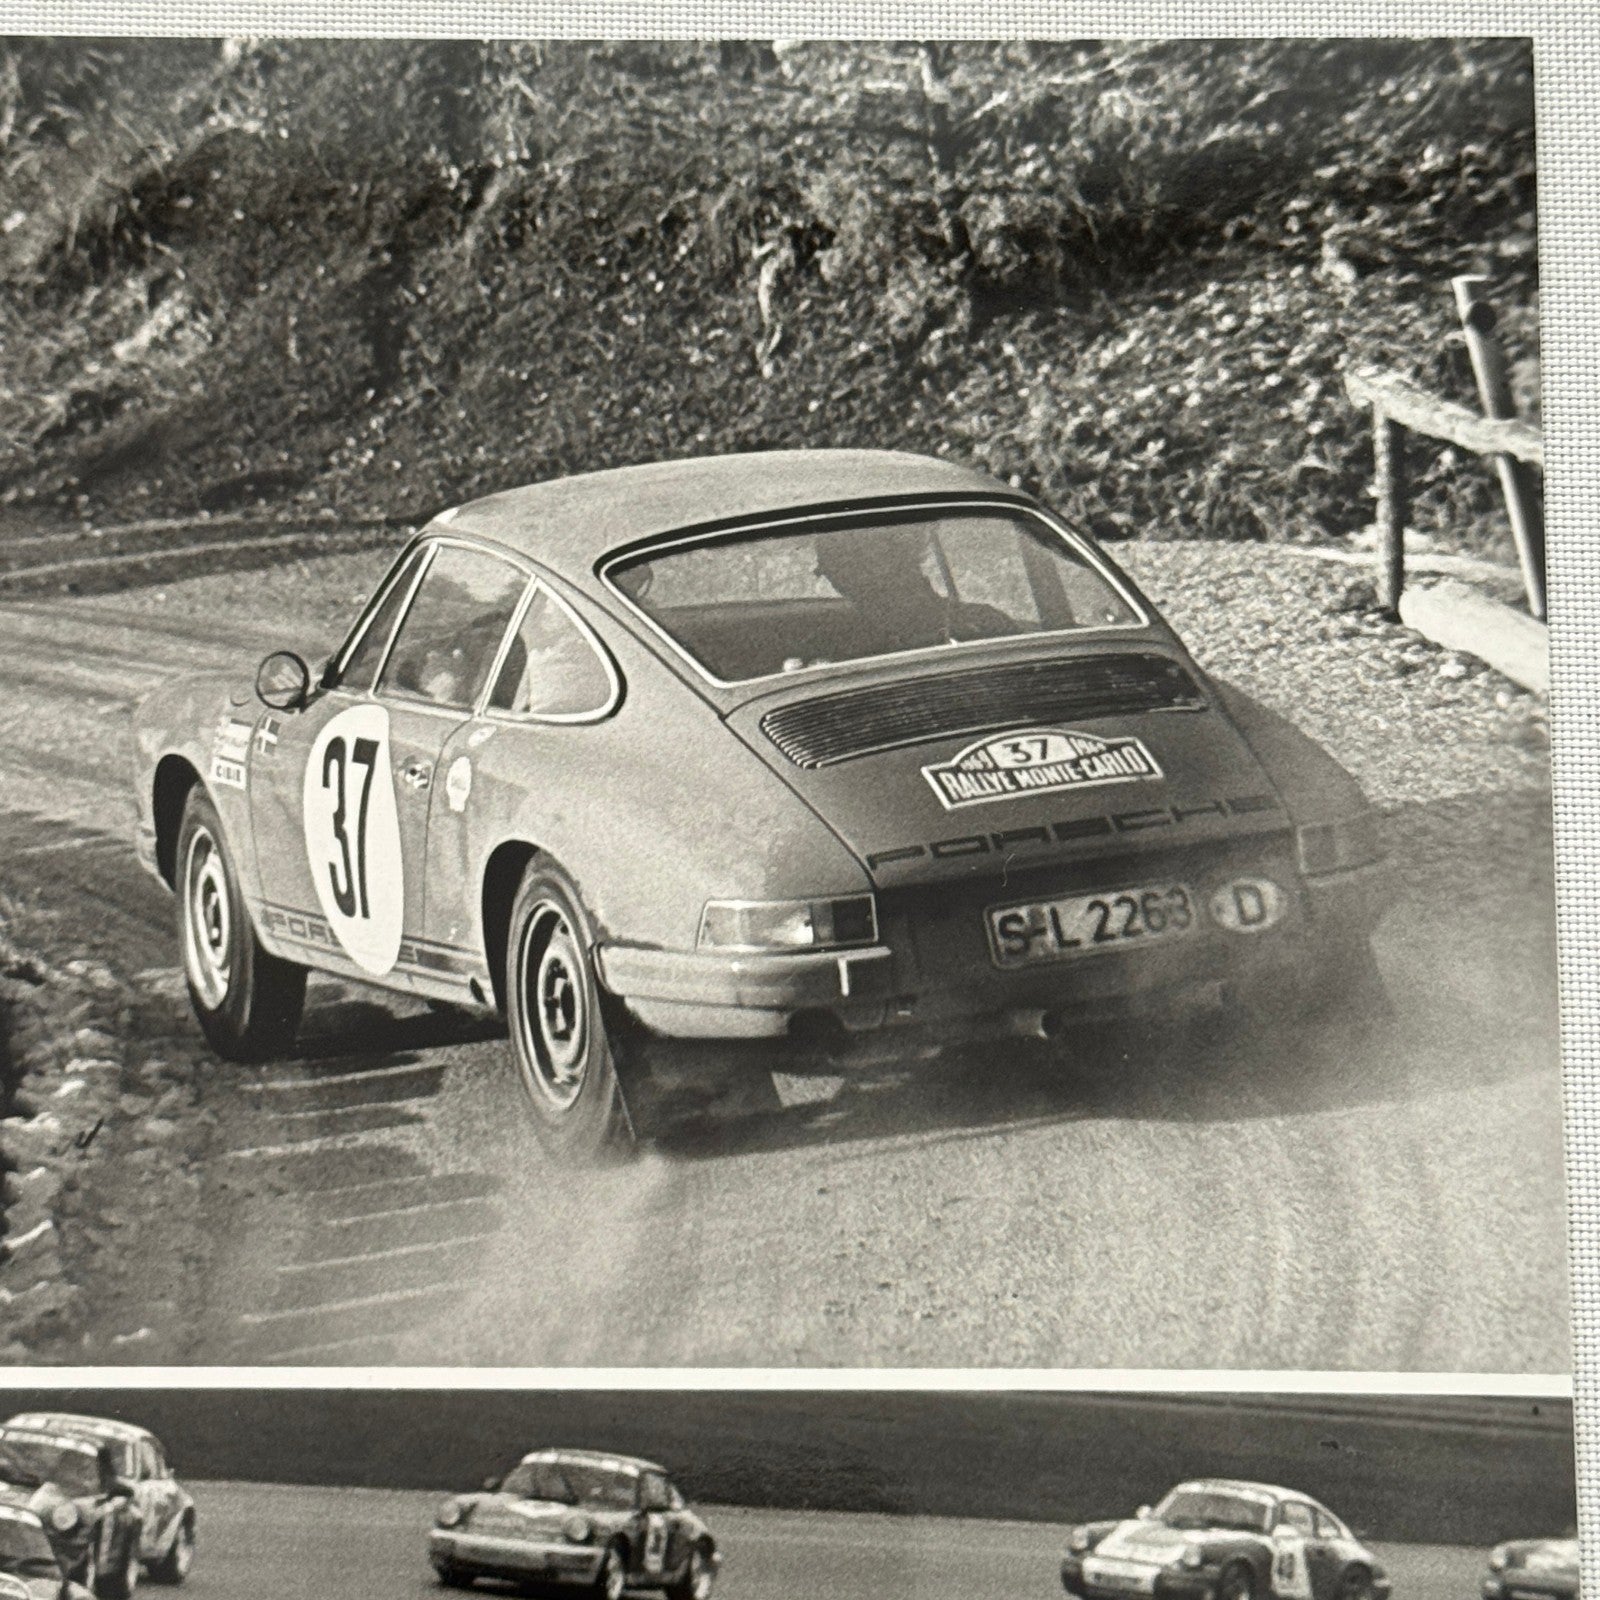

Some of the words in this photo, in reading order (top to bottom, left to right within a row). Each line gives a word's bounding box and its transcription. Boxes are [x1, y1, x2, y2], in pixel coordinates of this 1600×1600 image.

[1002, 738, 1048, 763] 37
[939, 771, 1016, 799] RALLYE
[323, 736, 380, 919] 37
[866, 795, 1281, 870] PORSCHE
[1232, 886, 1266, 926] D
